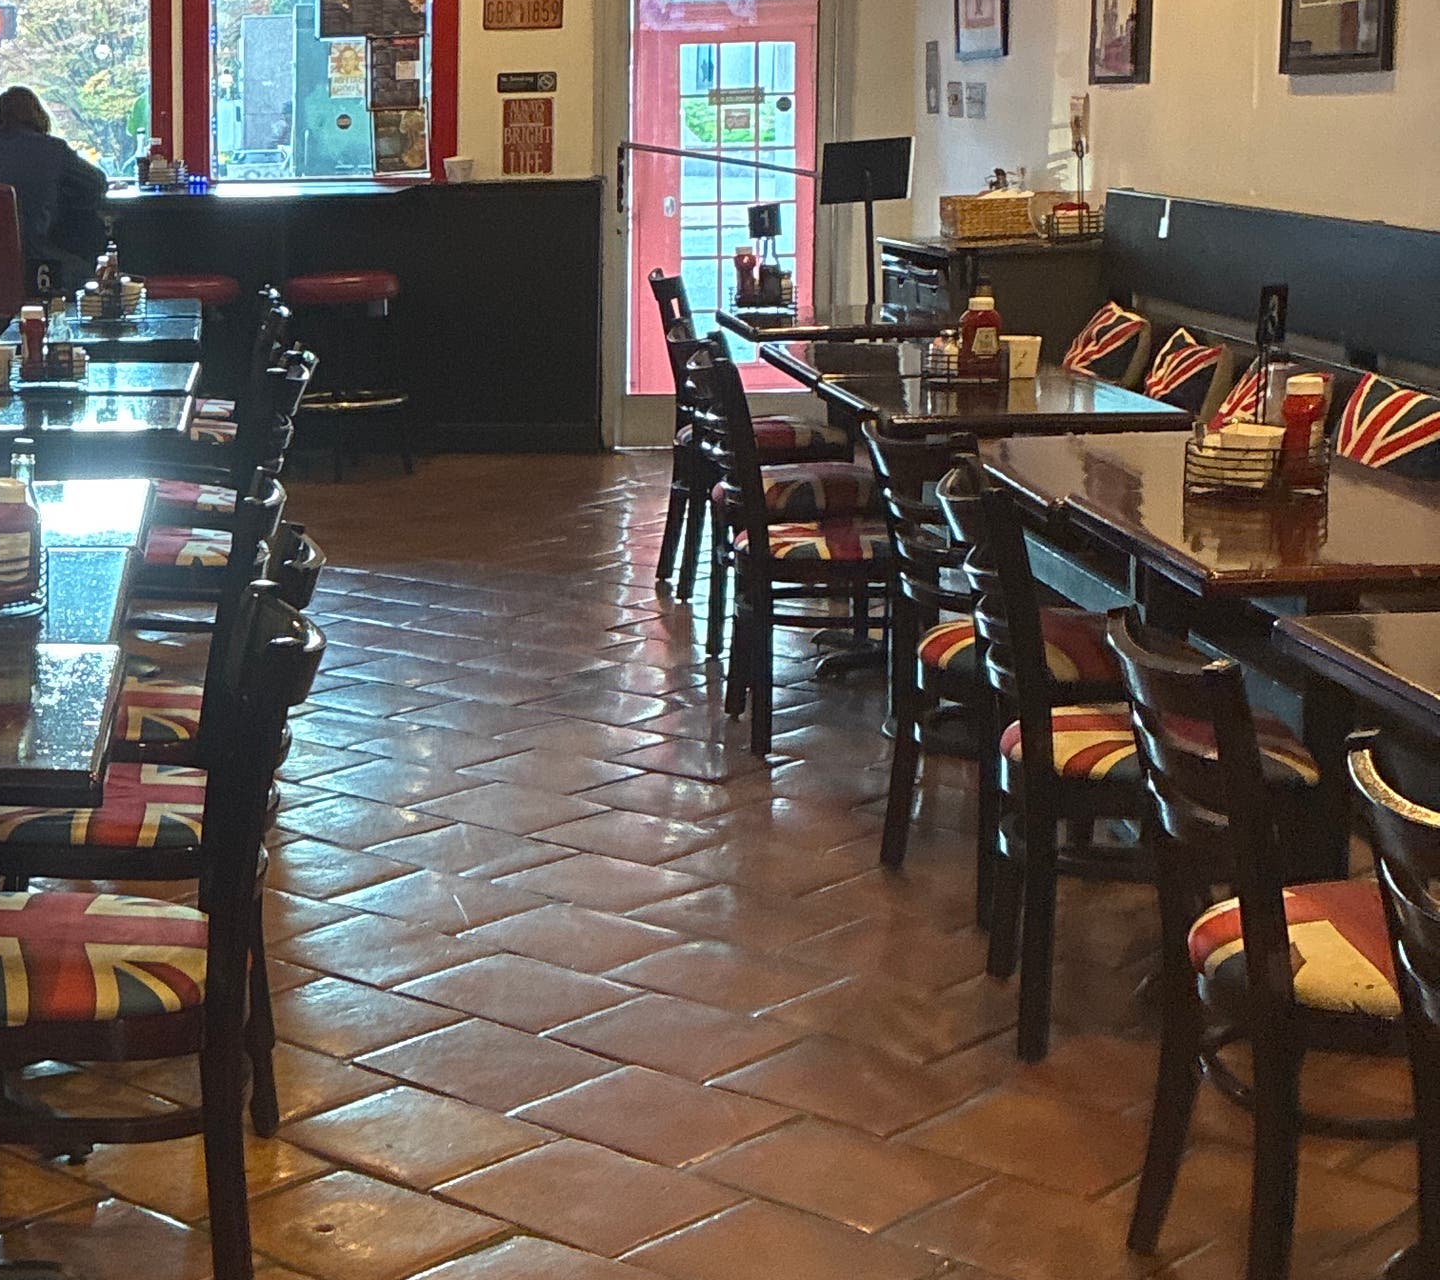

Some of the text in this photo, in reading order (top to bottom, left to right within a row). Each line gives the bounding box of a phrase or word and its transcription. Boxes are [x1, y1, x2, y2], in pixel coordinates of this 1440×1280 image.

[504, 126, 552, 145] BRIGHT
[509, 151, 544, 175] LIFE
[37, 264, 50, 292] 6
